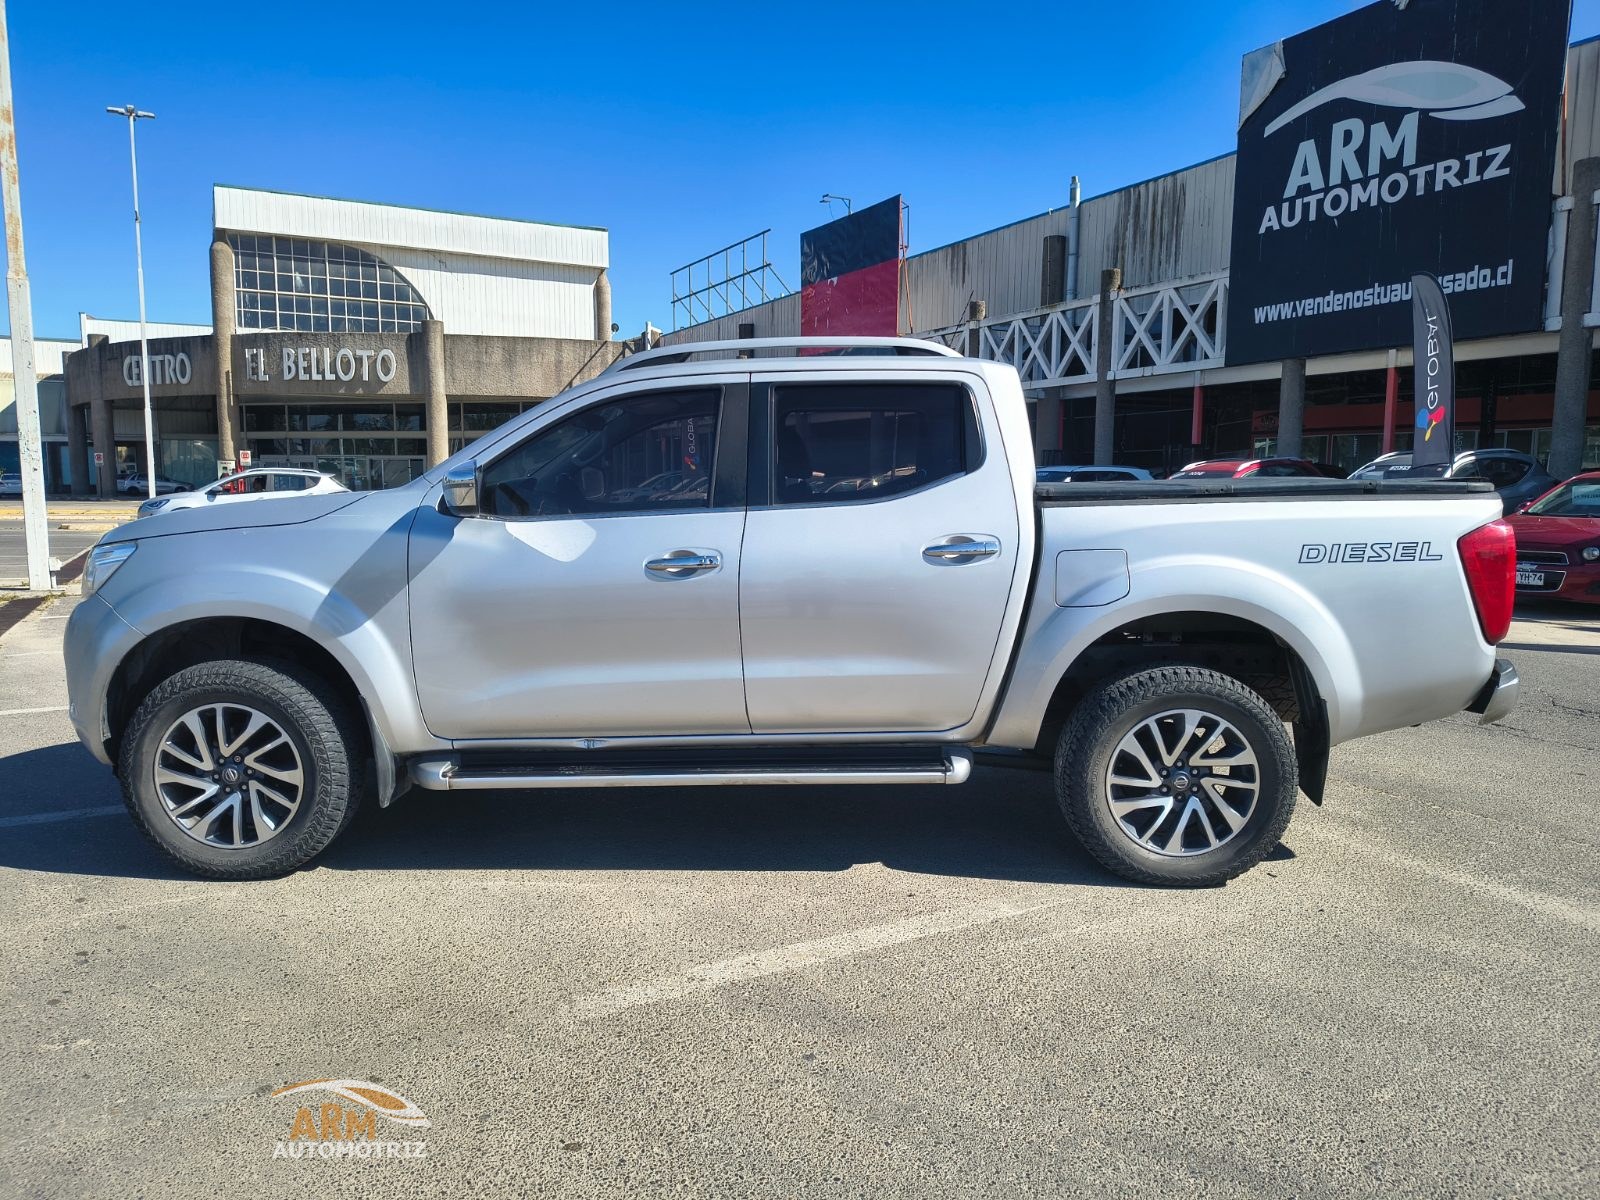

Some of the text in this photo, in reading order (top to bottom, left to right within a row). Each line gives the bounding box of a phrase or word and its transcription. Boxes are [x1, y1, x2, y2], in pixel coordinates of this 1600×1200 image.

[1283, 111, 1420, 199] ARM
[1258, 144, 1512, 234] AUTOMOTRIZ
[1254, 259, 1513, 324] www.vendenostuausado.cl
[245, 347, 397, 383] EL BELLOTO
[1298, 541, 1443, 564] DIESEL
[1519, 573, 1543, 582] YH-74
